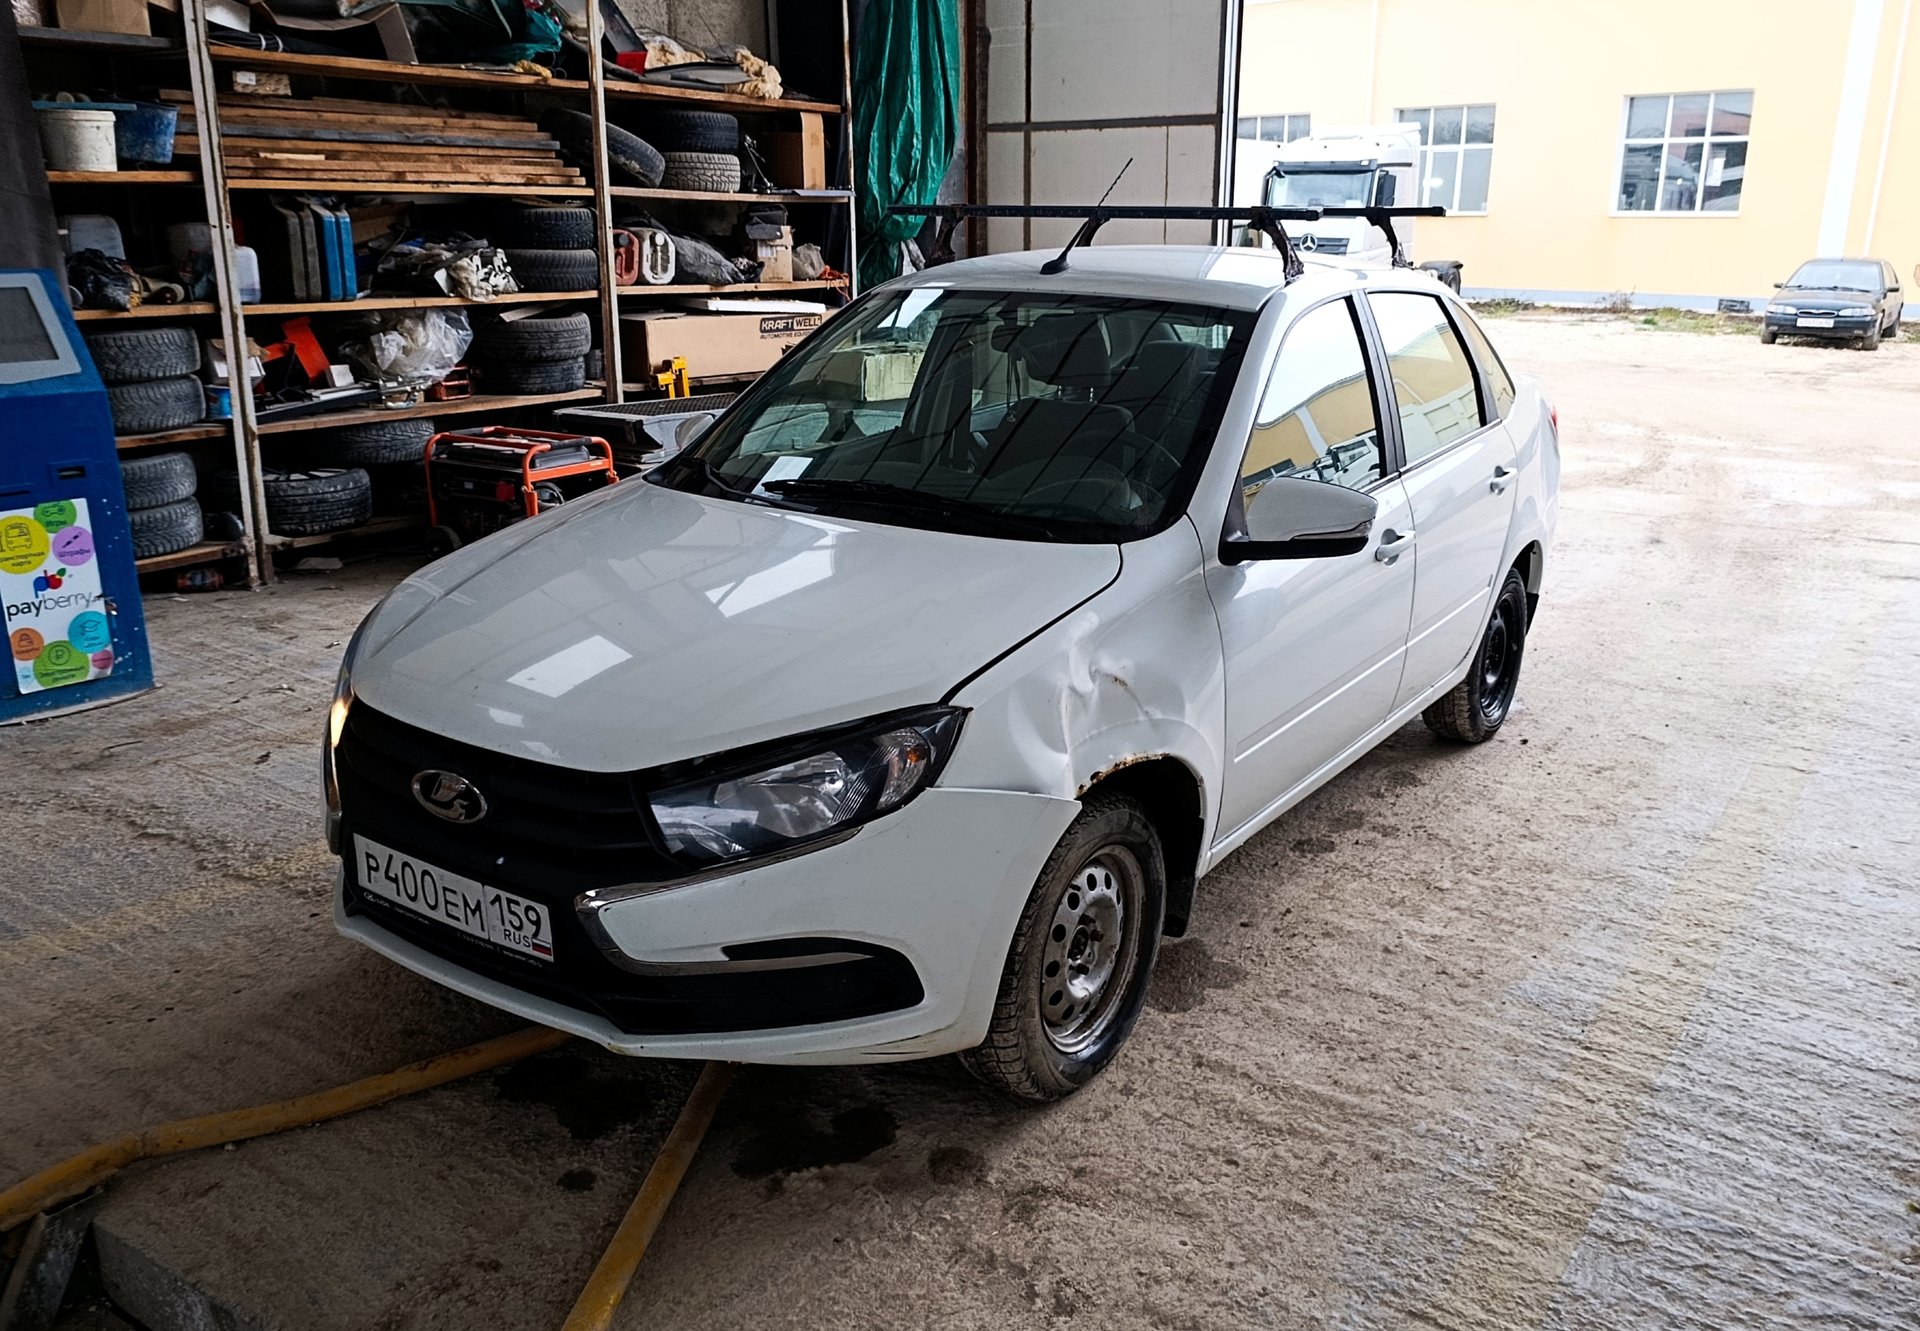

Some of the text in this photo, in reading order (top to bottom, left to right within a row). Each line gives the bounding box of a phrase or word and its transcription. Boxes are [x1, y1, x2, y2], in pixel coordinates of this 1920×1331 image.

[761, 317, 819, 331] KRAFT WELL
[760, 332, 793, 340] AUTOMOTIVE
[6, 592, 93, 622] payberry
[490, 893, 542, 938] 159
[503, 929, 531, 949] RUS
